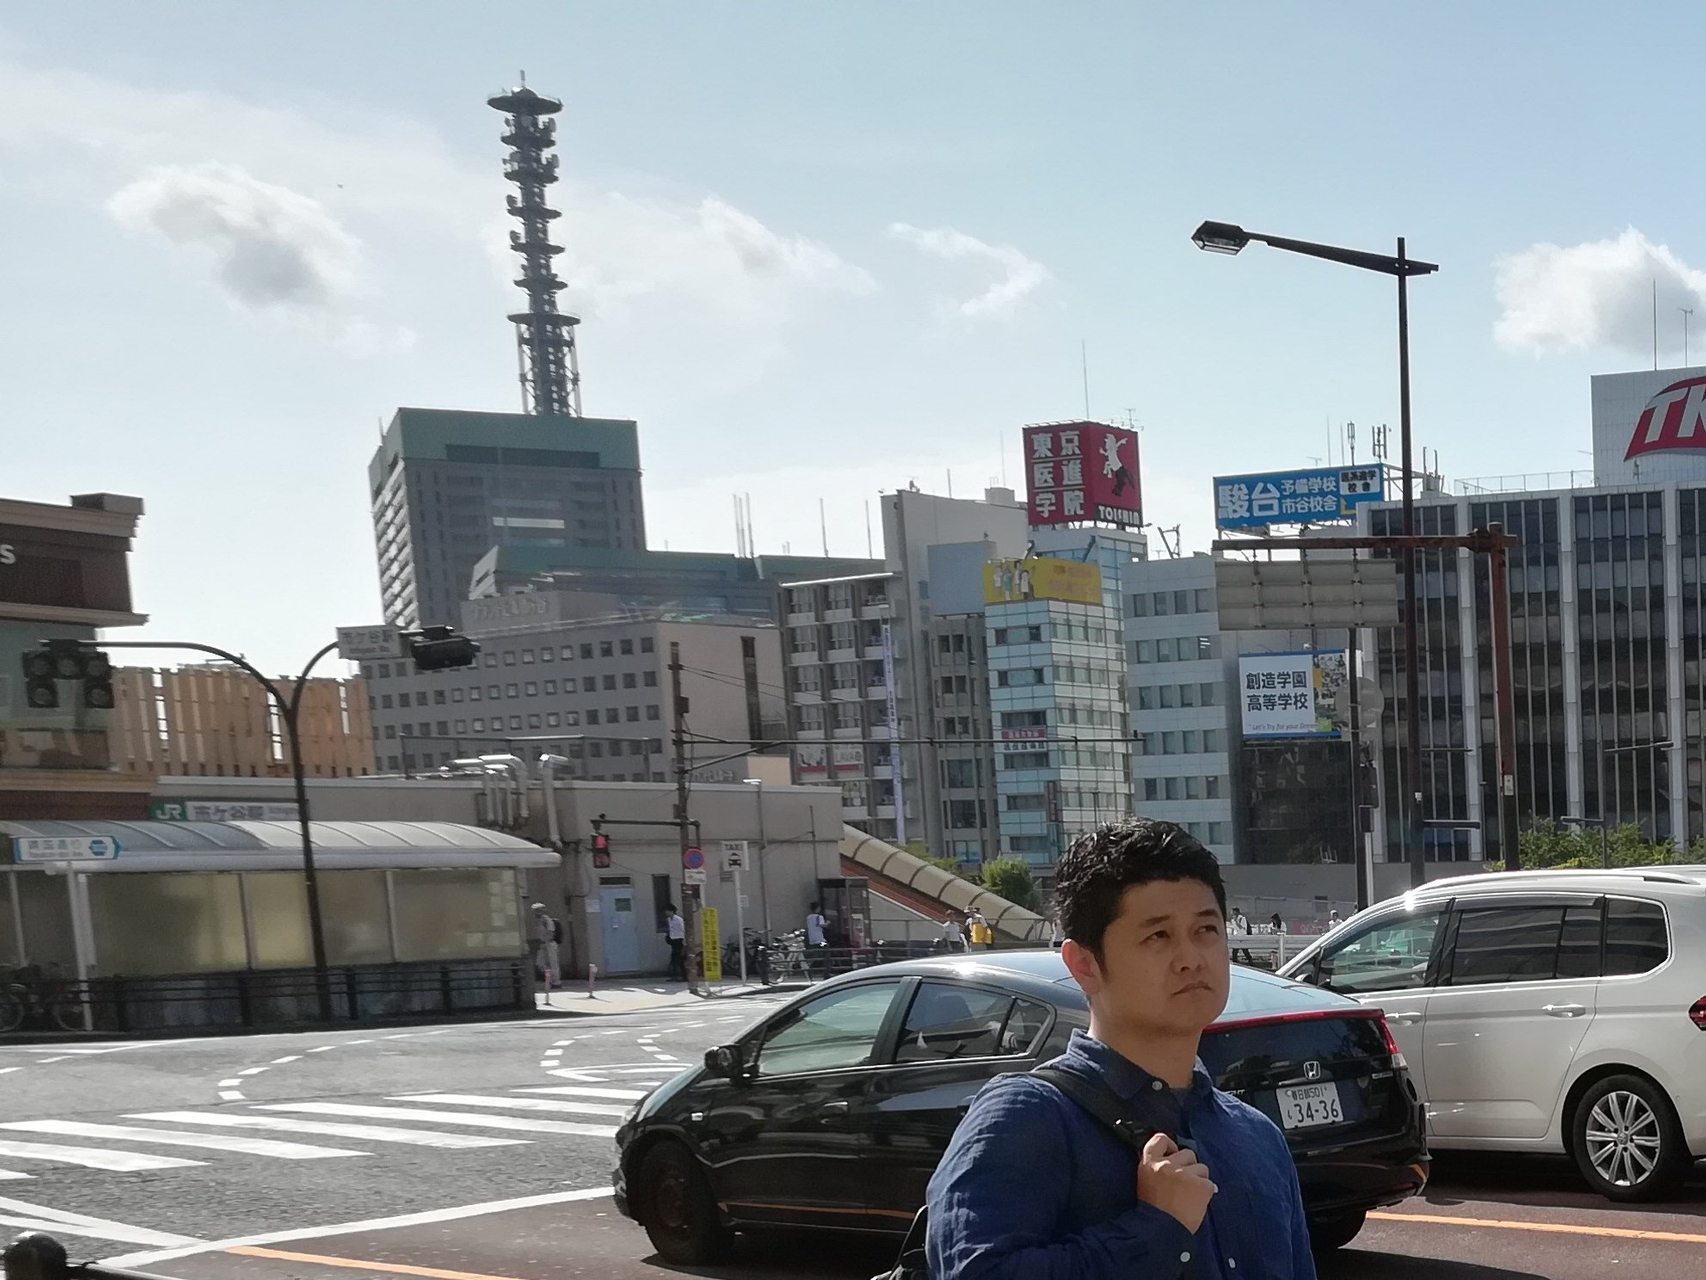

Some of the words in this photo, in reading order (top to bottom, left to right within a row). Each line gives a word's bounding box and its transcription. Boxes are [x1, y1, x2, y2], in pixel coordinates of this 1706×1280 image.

[1031, 430, 1081, 459] 東京
[1033, 459, 1083, 488] 医進
[1281, 476, 1338, 496] 予備学校
[1035, 490, 1085, 518] 学院
[1217, 482, 1281, 519] 駿台
[1282, 494, 1339, 514] 市谷校舎
[1245, 670, 1307, 690] 創造学園
[1247, 692, 1309, 712] 高等学校
[155, 804, 181, 820] JR
[1308, 1086, 1325, 1098] 501
[1293, 1098, 1339, 1123] 34-36
